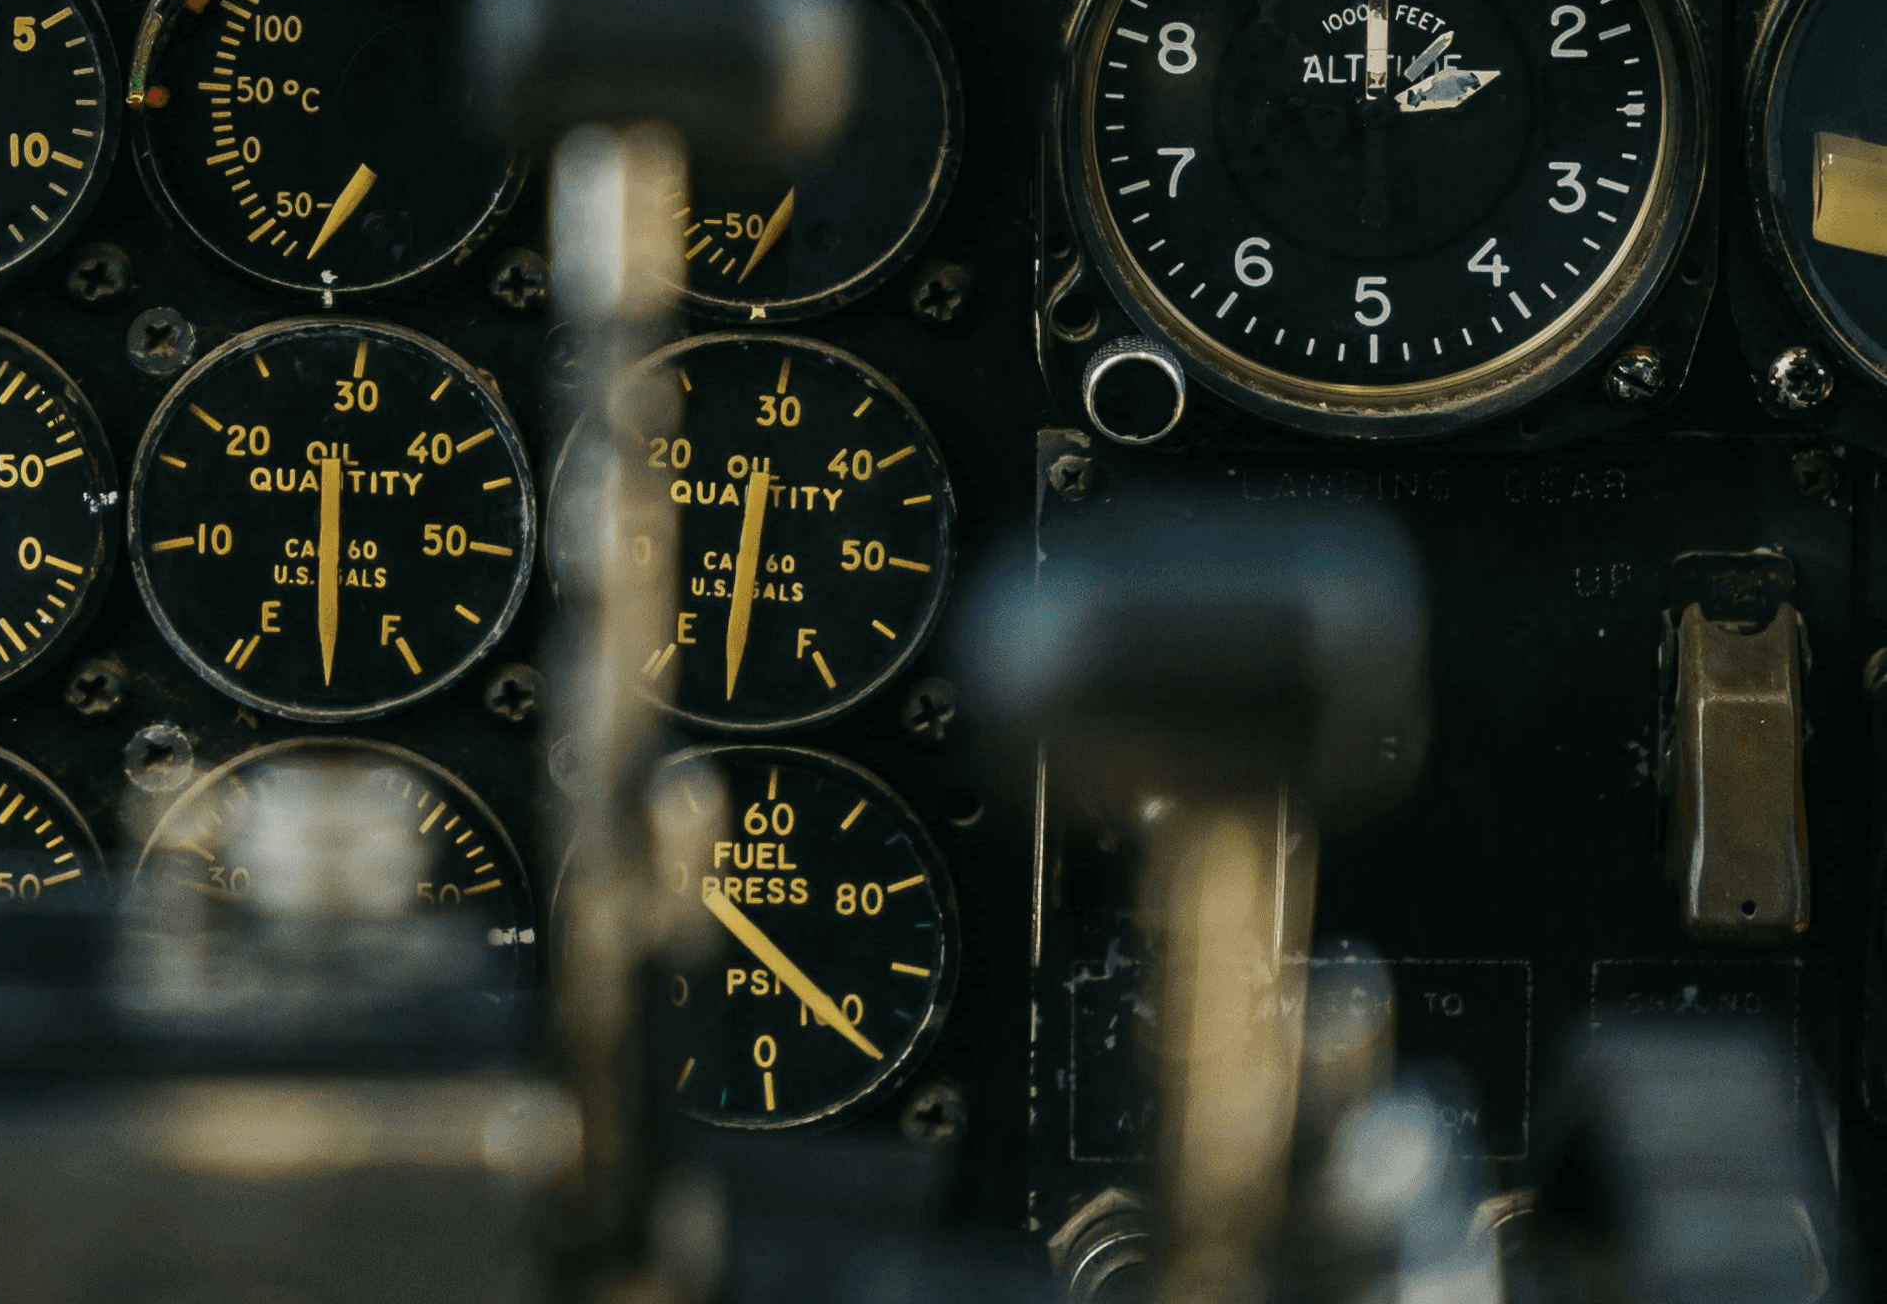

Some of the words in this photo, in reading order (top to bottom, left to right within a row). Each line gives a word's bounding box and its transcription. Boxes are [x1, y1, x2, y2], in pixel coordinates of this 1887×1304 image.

[1395, 4, 1446, 33] FEET
[1158, 22, 1198, 75] 8
[9, 132, 50, 168] 10
[1157, 147, 1195, 198] 7
[1468, 237, 1510, 287] 4
[1354, 275, 1391, 327] 5
[333, 380, 378, 412] 30
[226, 425, 270, 457] 20
[407, 432, 453, 465] 40
[249, 468, 423, 496] QUATITY
[198, 523, 232, 555] 10
[347, 540, 378, 559] 60
[422, 523, 467, 557] 50
[840, 539, 885, 573] 50
[261, 601, 282, 633] E
[381, 615, 401, 646] F
[743, 802, 795, 836] 60
[714, 842, 797, 870] FUEL
[702, 876, 809, 905] PRESS
[836, 882, 884, 916] 80
